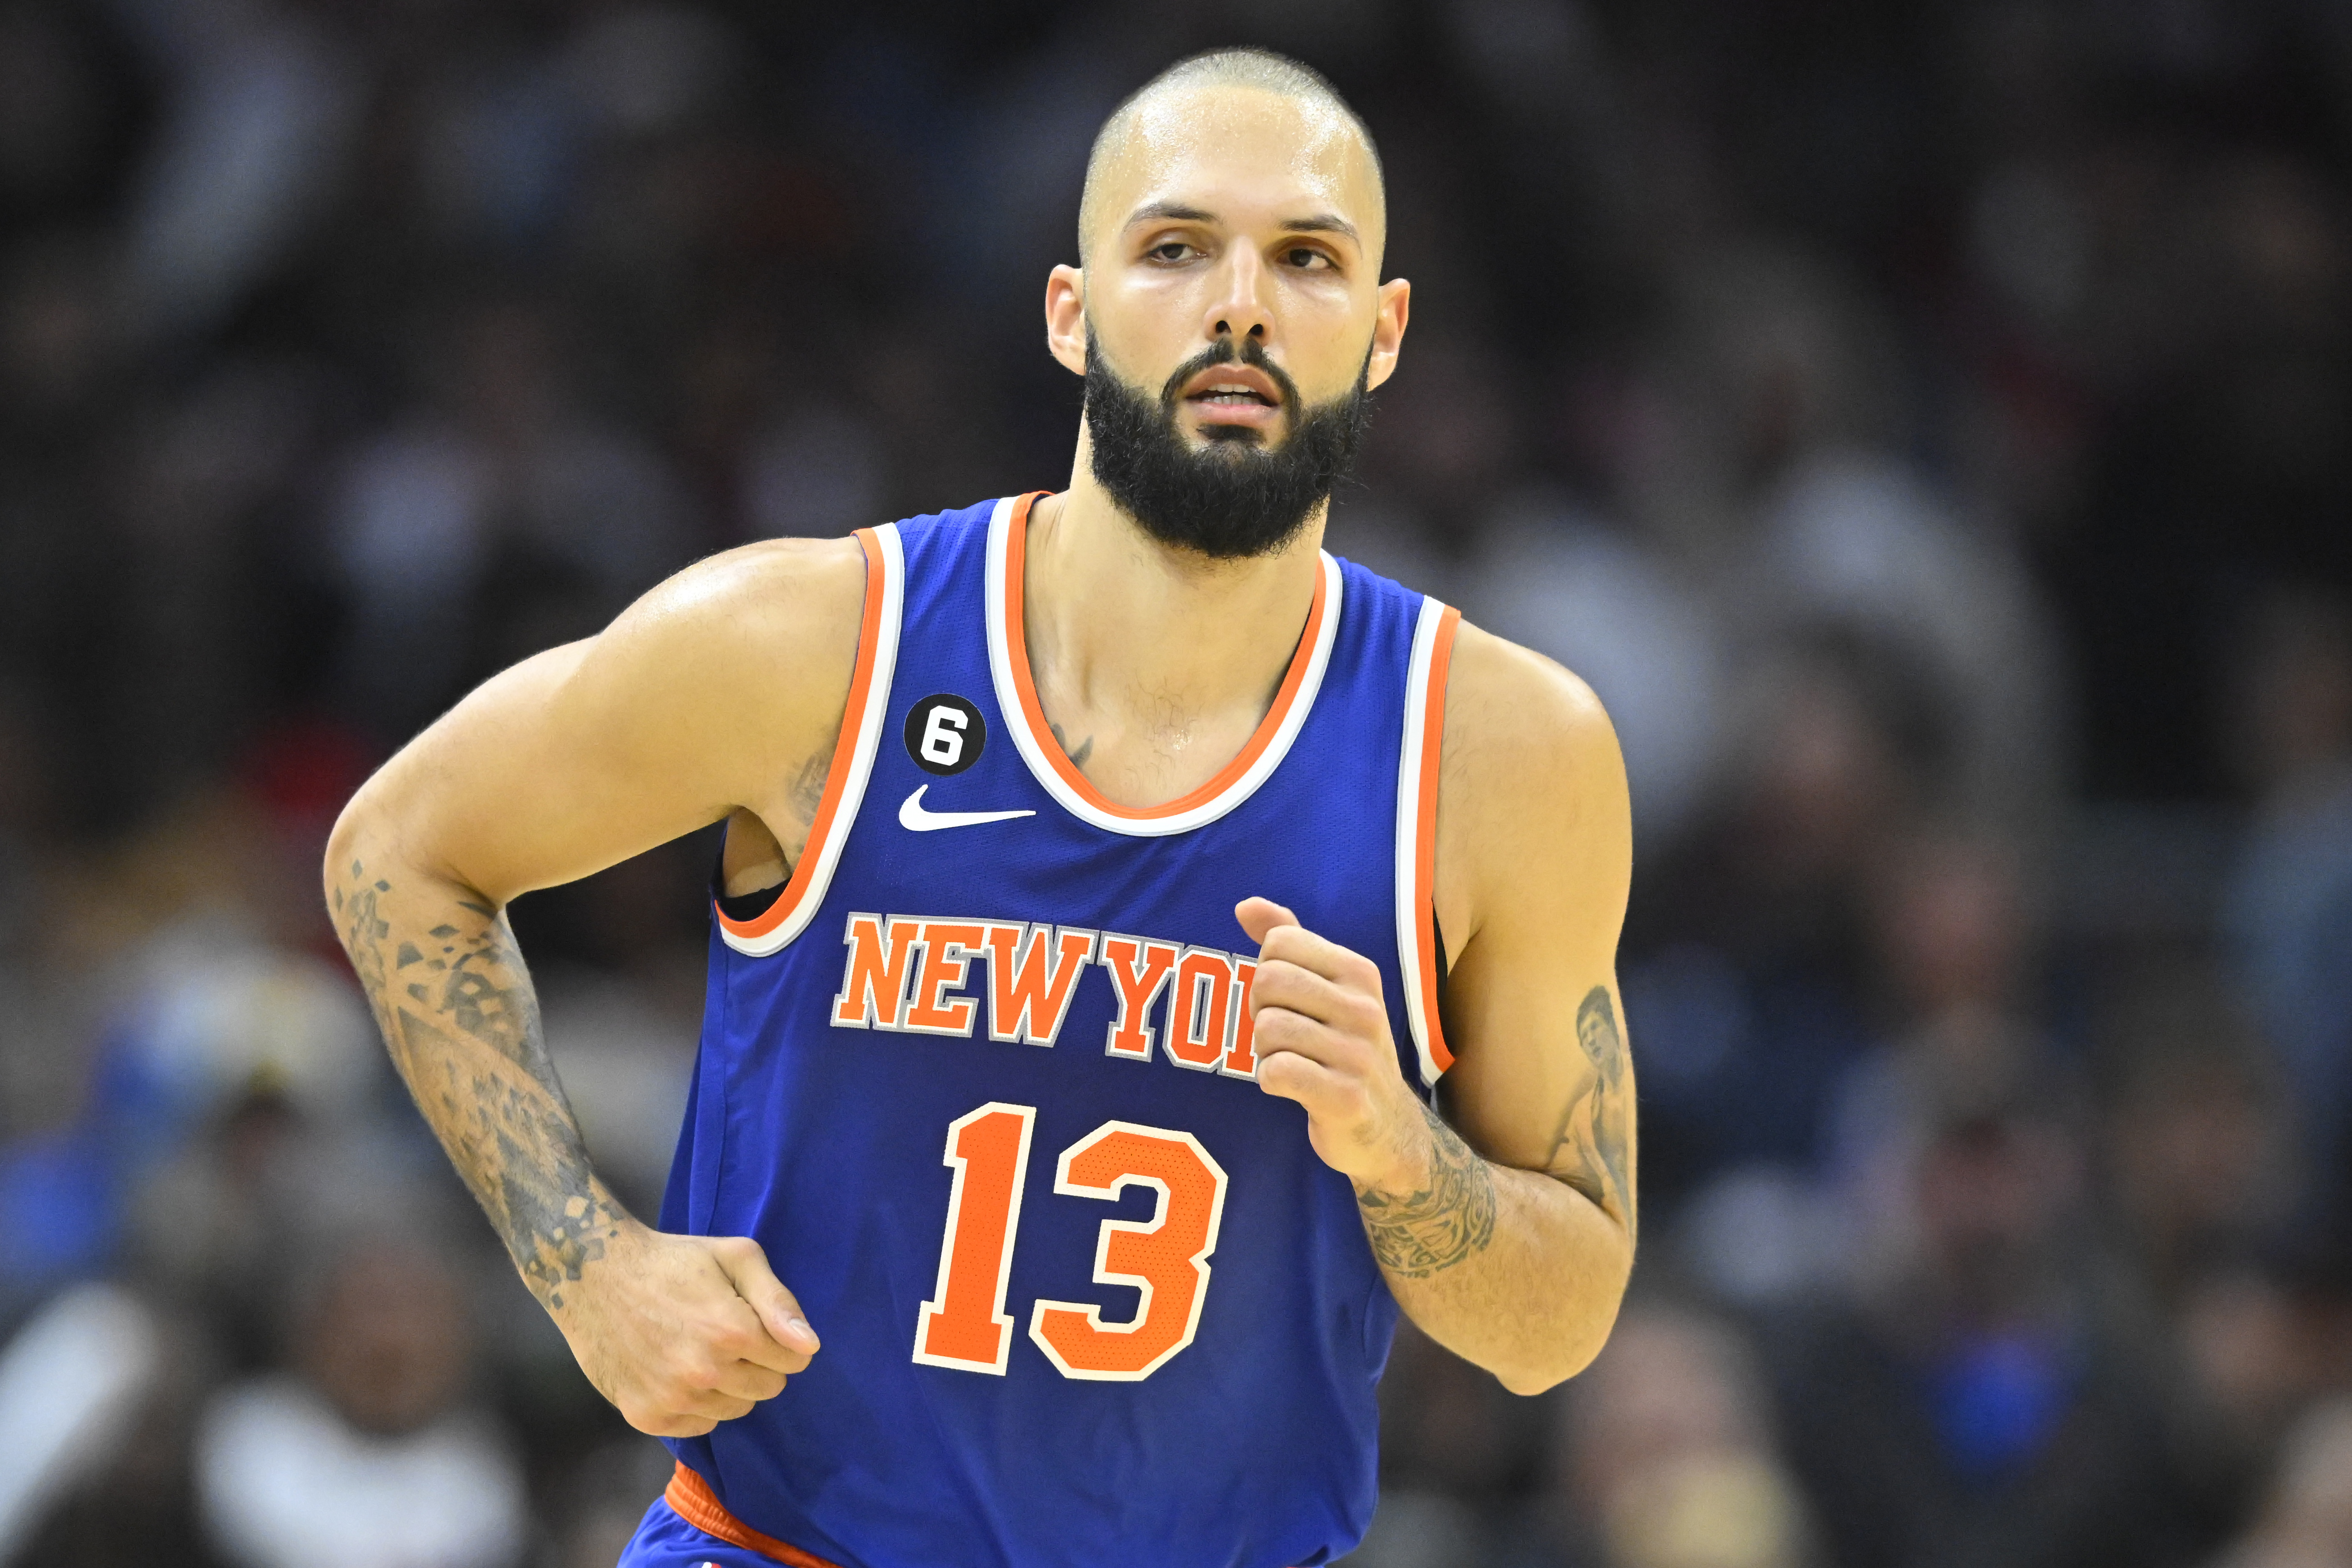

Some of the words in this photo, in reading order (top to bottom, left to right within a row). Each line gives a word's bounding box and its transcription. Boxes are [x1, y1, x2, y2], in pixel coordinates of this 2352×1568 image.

[921, 705, 968, 766] 6
[831, 912, 1100, 1047] NEW
[912, 1101, 1228, 1381] 13
